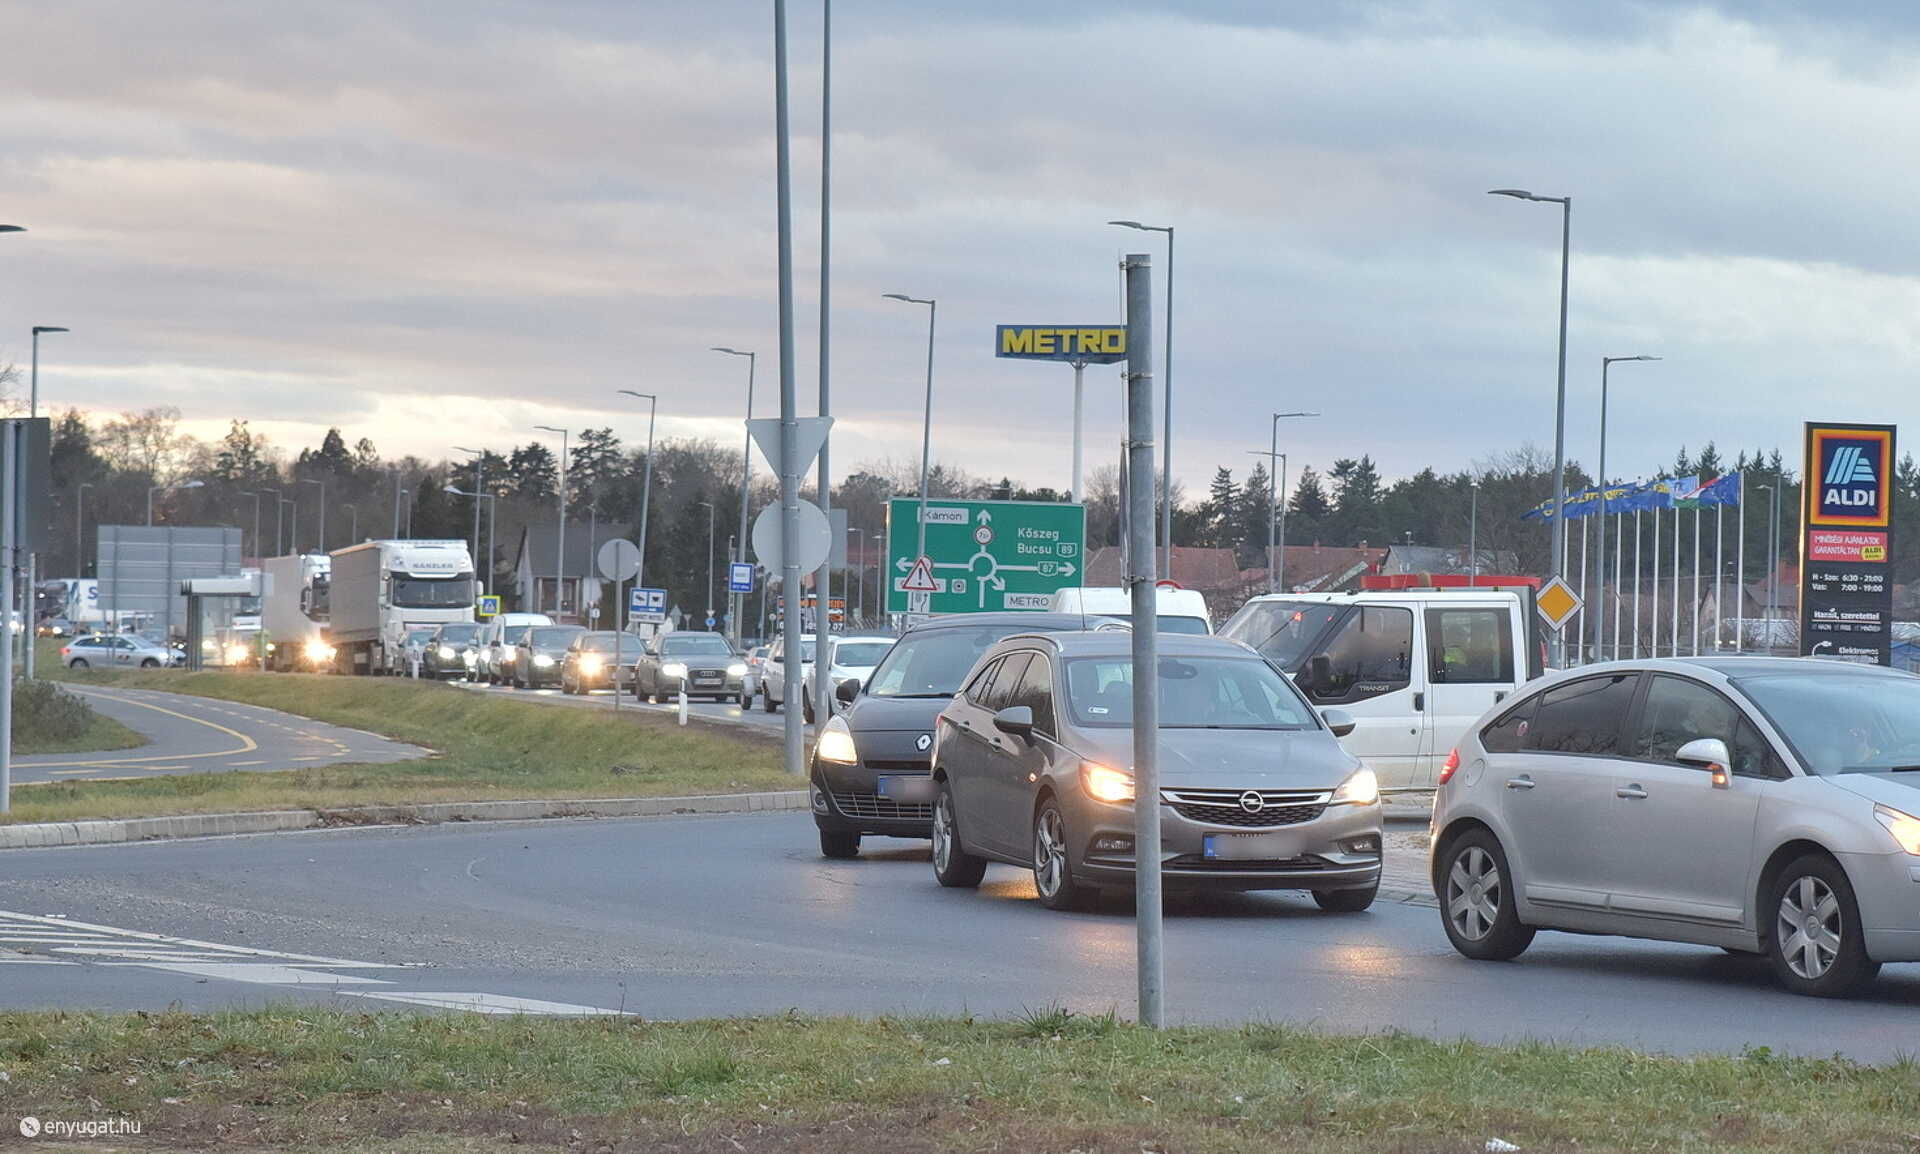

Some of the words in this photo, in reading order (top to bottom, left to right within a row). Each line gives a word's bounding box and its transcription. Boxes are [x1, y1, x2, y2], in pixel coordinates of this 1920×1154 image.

[1002, 328, 1126, 353] METRO
[1824, 488, 1876, 506] ALDI
[1017, 527, 1059, 541] Kőszeg
[1017, 544, 1052, 554] Bucsu
[1061, 545, 1073, 554] 89
[1841, 584, 1858, 592] 7:00
[1009, 597, 1049, 606] METRO
[1359, 684, 1390, 692] TRANSIT
